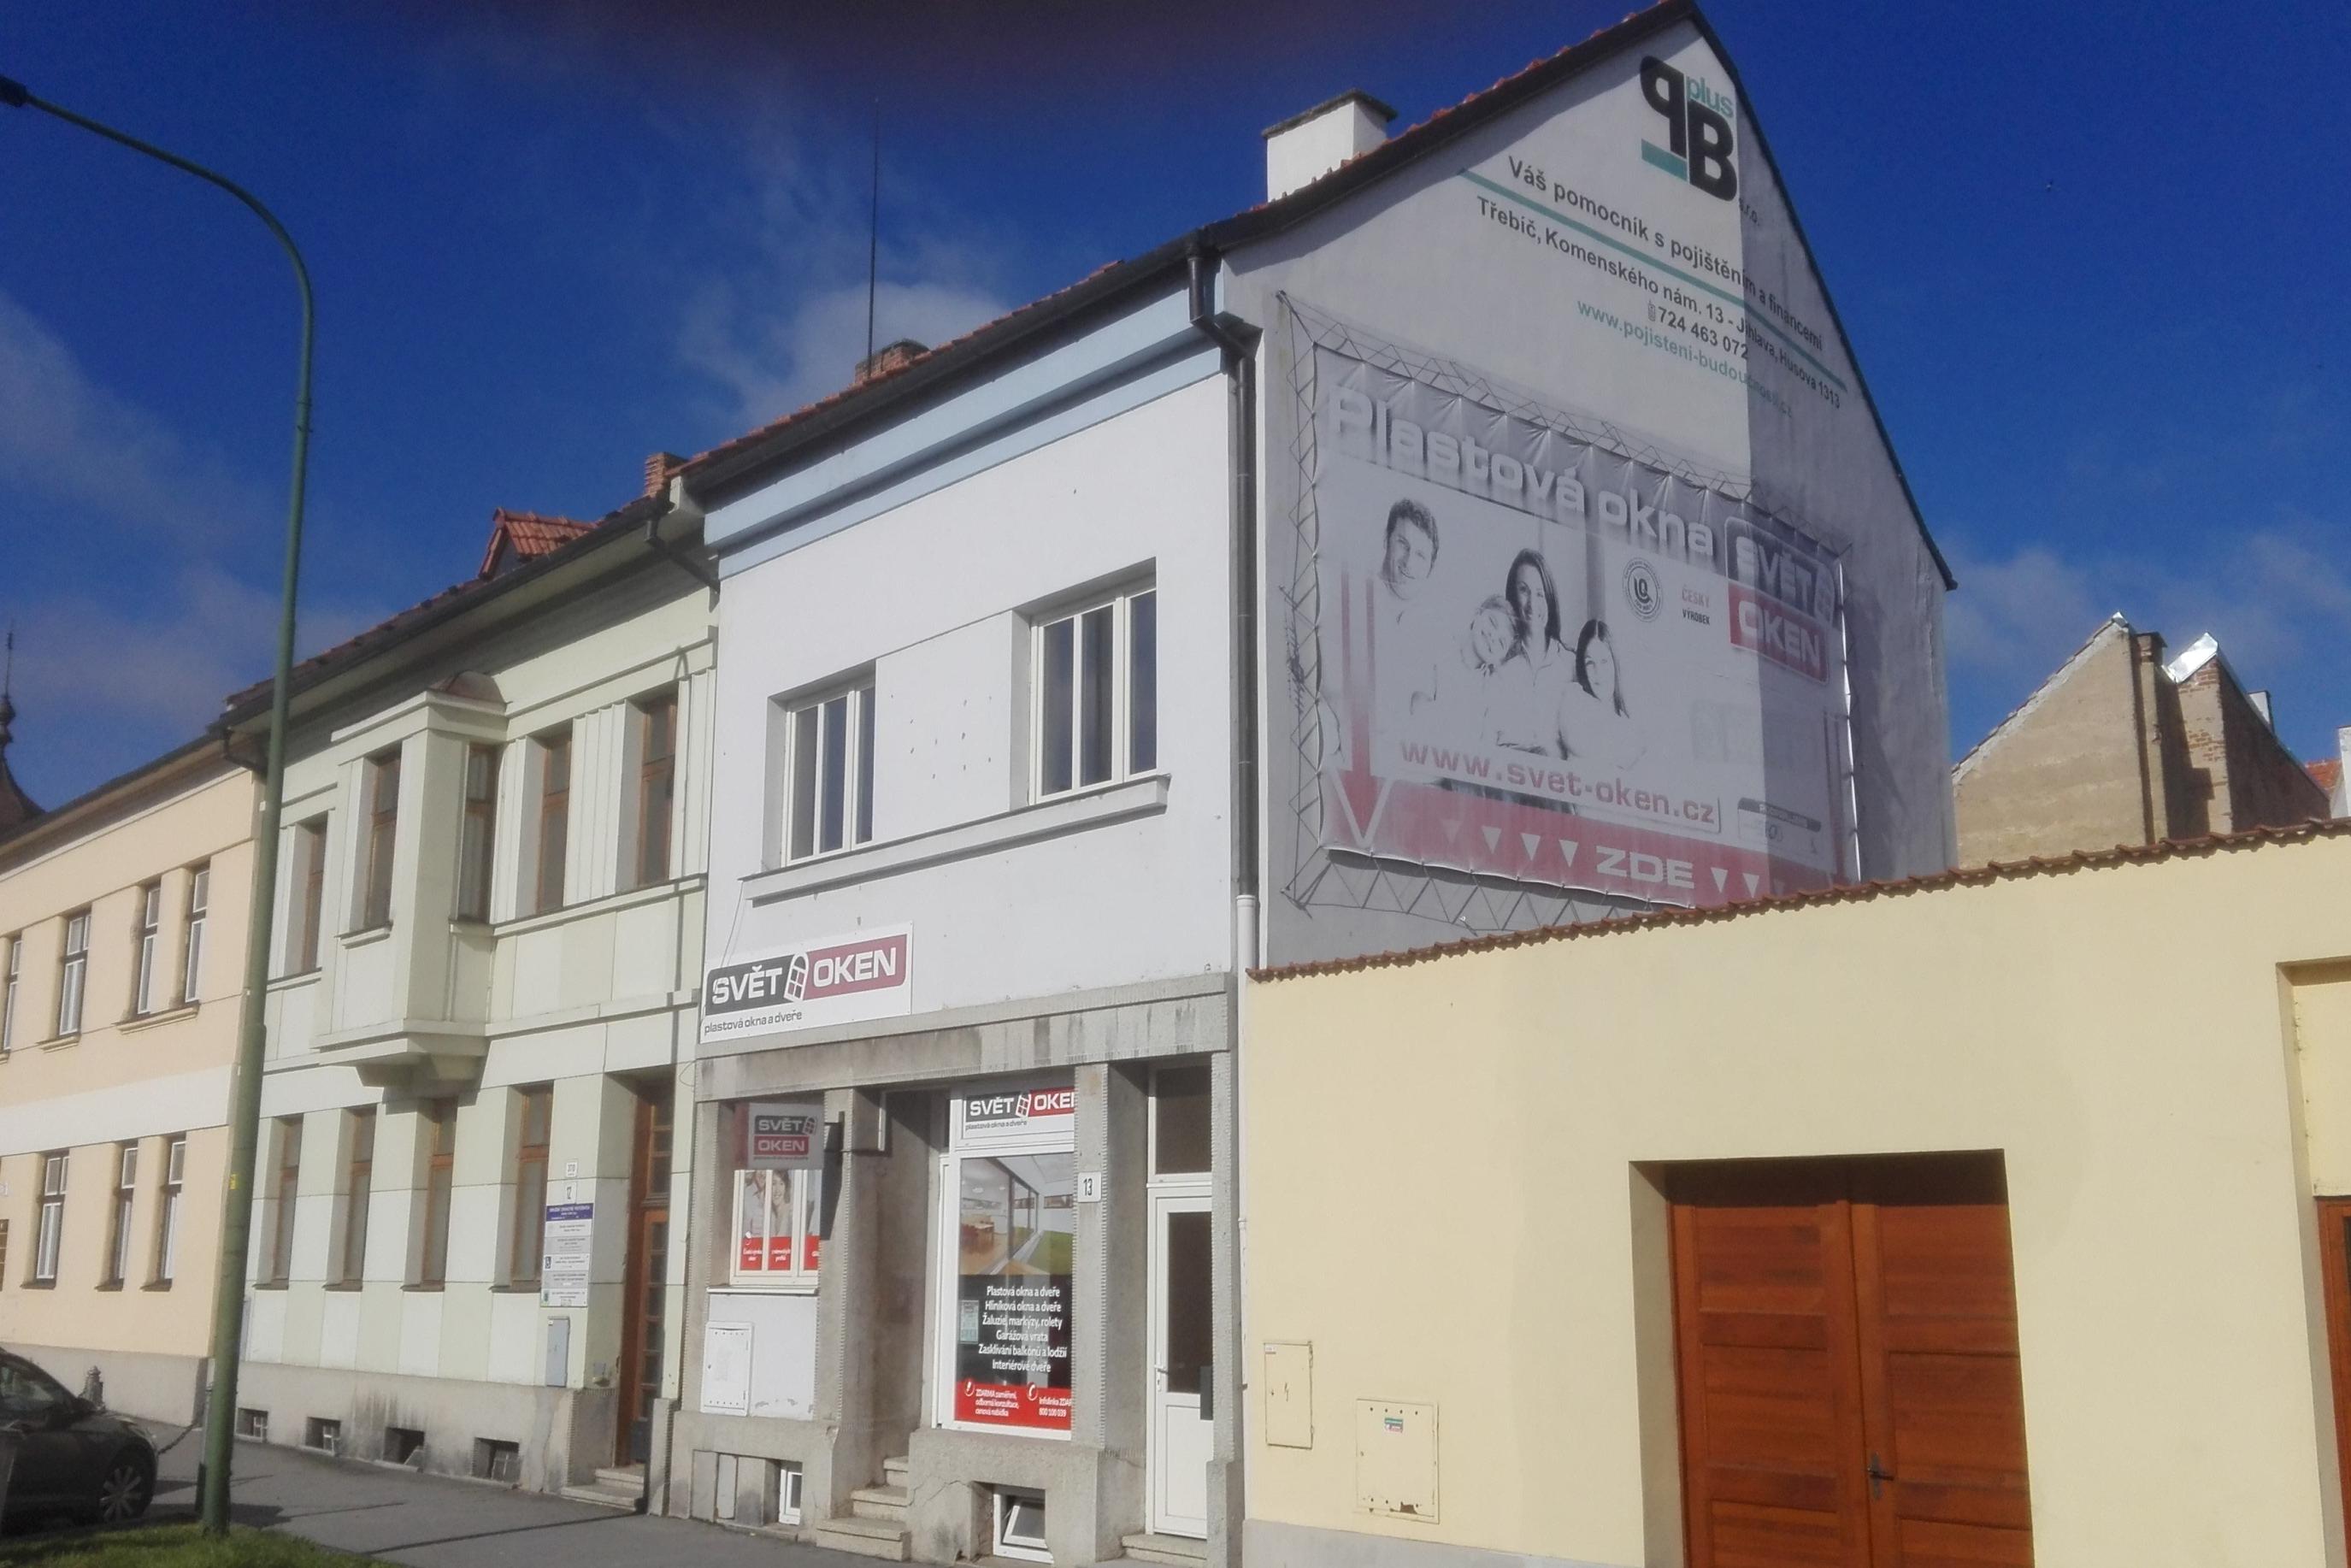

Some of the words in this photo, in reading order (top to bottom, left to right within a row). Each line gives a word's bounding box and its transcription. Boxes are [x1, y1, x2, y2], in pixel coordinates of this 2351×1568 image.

[1686, 76, 1734, 118] plus
[1509, 156, 1547, 191] Váš
[1553, 182, 1648, 241] pomocník
[1654, 232, 1665, 247] s
[1670, 239, 1756, 295] pojištěním
[1759, 290, 1766, 304] a
[1769, 293, 1823, 351] financemi
[1477, 196, 1541, 244] Třebíč,
[1546, 227, 1659, 294] Komenského
[1664, 286, 1701, 315] nám.
[1706, 304, 1723, 324] 13
[1736, 317, 1778, 363] Jihlava,
[1780, 352, 1816, 390] Husova
[1818, 380, 1841, 410] 1313
[1659, 306, 1686, 333] 724
[1691, 322, 1718, 346] 463
[1723, 335, 1748, 361] 072
[1329, 386, 1586, 513] Plastová
[1598, 487, 1713, 556] okna
[1738, 600, 1820, 669] OKEN
[1401, 741, 1715, 824] www.svet-oken.cz
[1596, 846, 1694, 888] ZDE
[712, 965, 782, 1005] SVĚT
[813, 947, 897, 987] OKEN
[704, 1018, 744, 1035] plastová
[745, 1015, 767, 1027] okna
[768, 1016, 774, 1024] a
[775, 1010, 803, 1023] dveře
[970, 1097, 1015, 1116] SVĚT
[758, 1118, 803, 1131] SVĚT
[758, 1141, 804, 1152] OKEN
[1083, 1177, 1093, 1196] 13
[987, 1286, 1015, 1297] Plastová
[1016, 1286, 1033, 1297] okna
[1040, 1286, 1060, 1298] dveře
[985, 1300, 1016, 1312] Hliníková
[1016, 1300, 1034, 1312] okna
[1041, 1300, 1062, 1312] dveře
[1041, 1317, 1063, 1330] rolety
[1029, 1333, 1049, 1342] vrata
[1031, 1360, 1052, 1373] dveře
